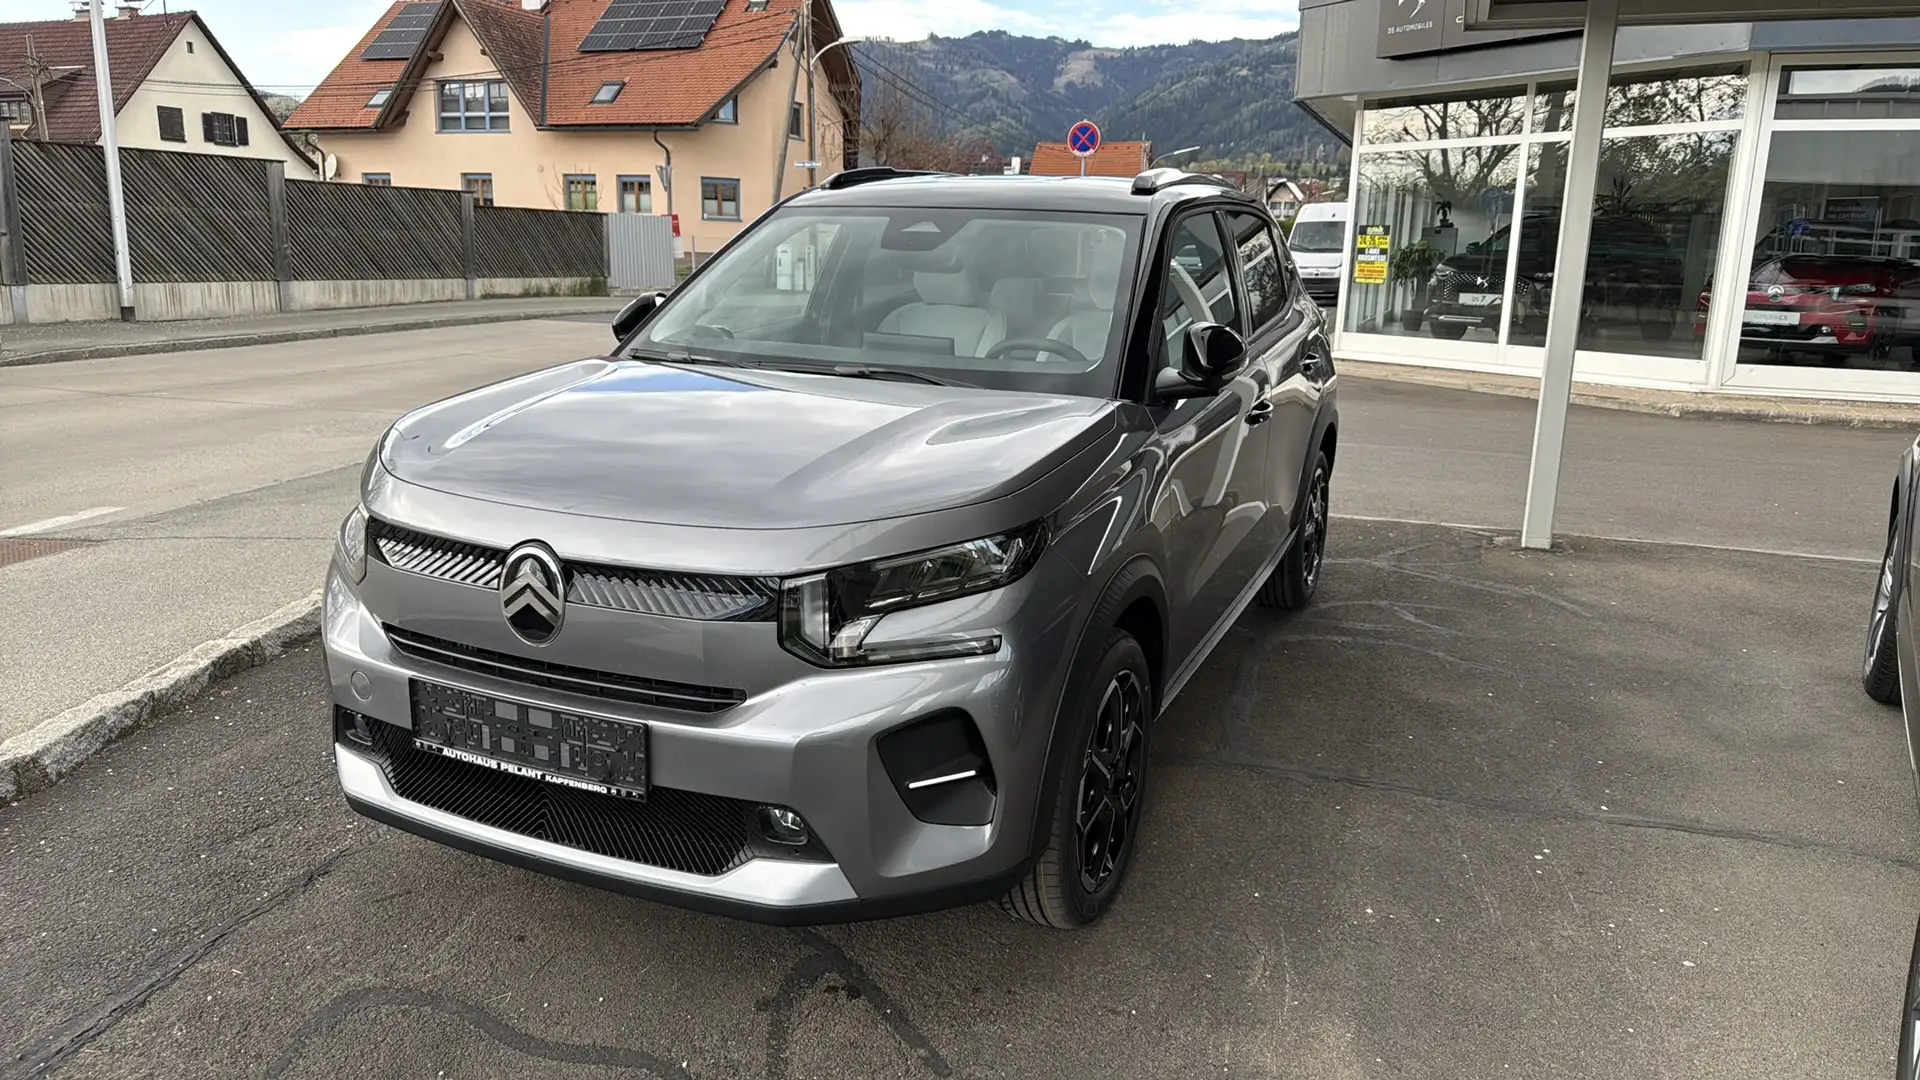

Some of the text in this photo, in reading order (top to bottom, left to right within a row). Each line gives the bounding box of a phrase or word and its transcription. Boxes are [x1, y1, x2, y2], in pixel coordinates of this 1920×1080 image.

[1395, 20, 1433, 32] AUTOMOBILES
[1480, 295, 1487, 304] 7
[442, 747, 611, 795] AUTOHAUS PELANT KAPFENBERG
